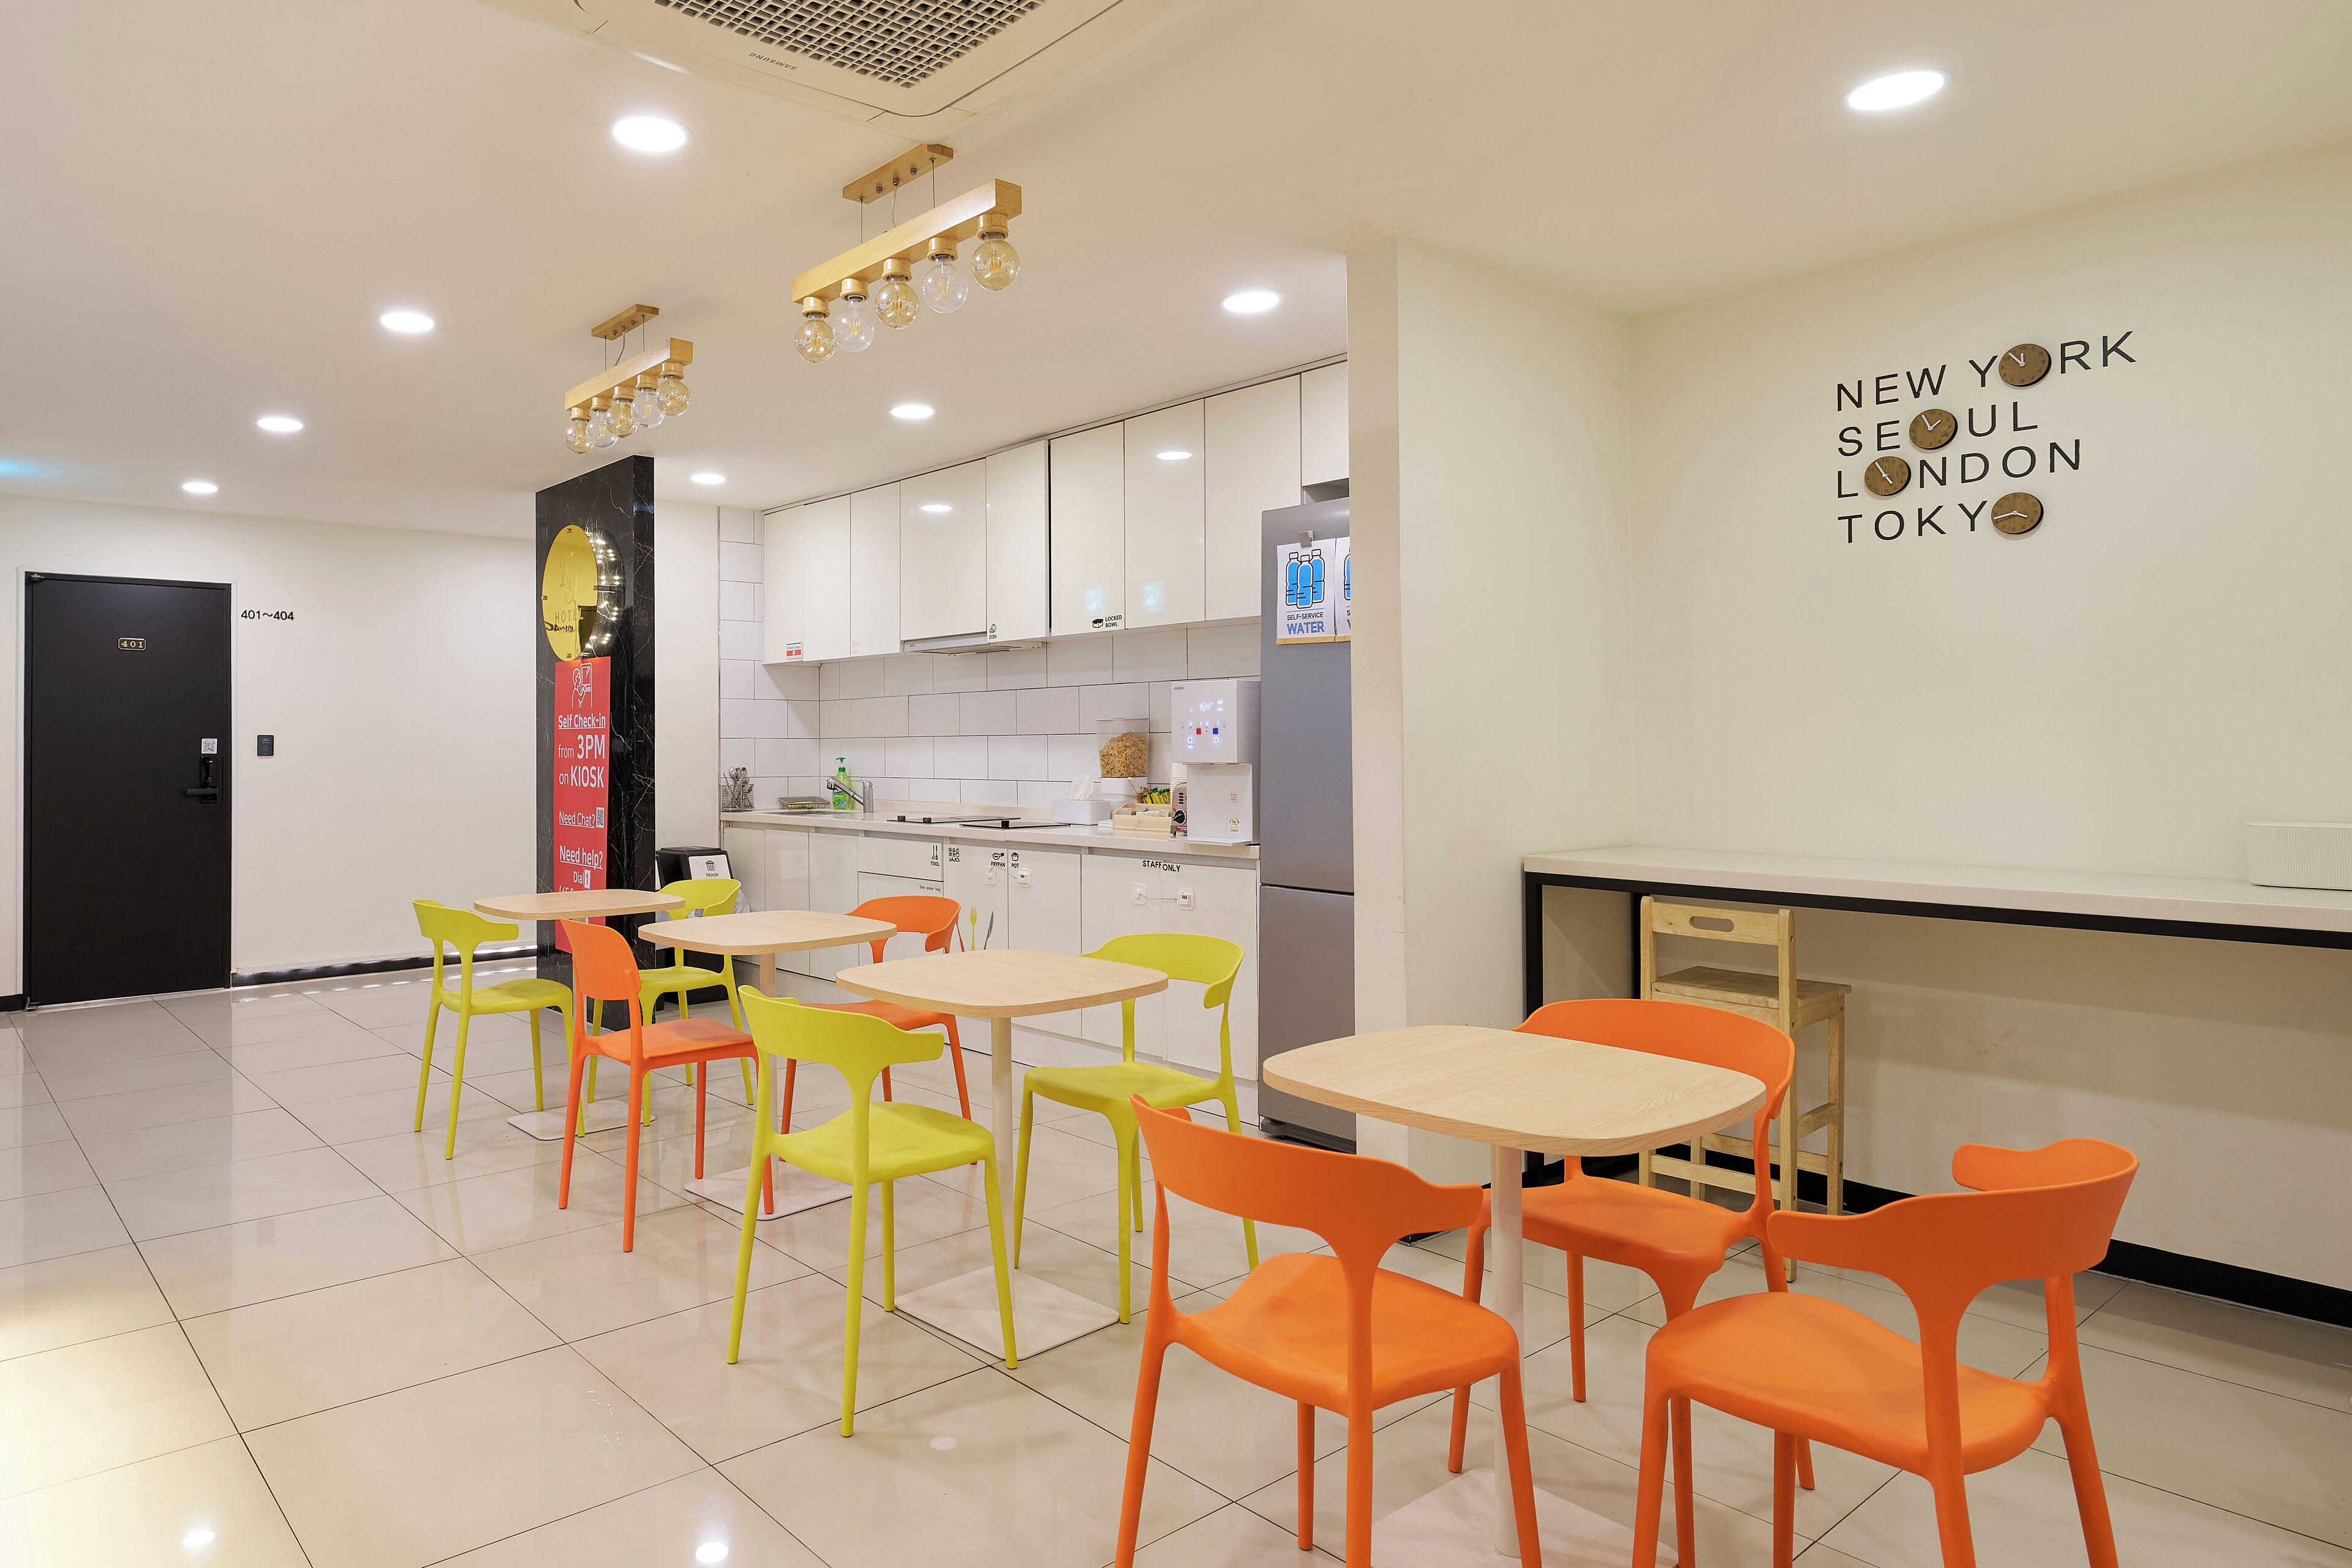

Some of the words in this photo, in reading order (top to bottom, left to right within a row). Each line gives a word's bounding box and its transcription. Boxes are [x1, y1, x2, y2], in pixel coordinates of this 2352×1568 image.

[749, 53, 797, 70] SAMSUNG
[1837, 364, 1947, 411] NEW
[555, 607, 584, 624] HOTEL
[1287, 612, 1324, 621] SELF-SERVICE
[1287, 620, 1325, 635] WATER
[558, 714, 573, 728] Self
[574, 712, 606, 728] Check-in
[558, 744, 575, 758] from
[577, 734, 605, 760] 3PM
[559, 773, 569, 785] on
[571, 765, 605, 788] KIOSK
[559, 810, 576, 825] Need
[577, 812, 595, 827] Chat?
[560, 845, 580, 863] Need
[582, 847, 603, 870] help?
[1143, 860, 1162, 869] STAFF
[1162, 864, 1181, 872] ONLY
[573, 871, 584, 884] Dial
